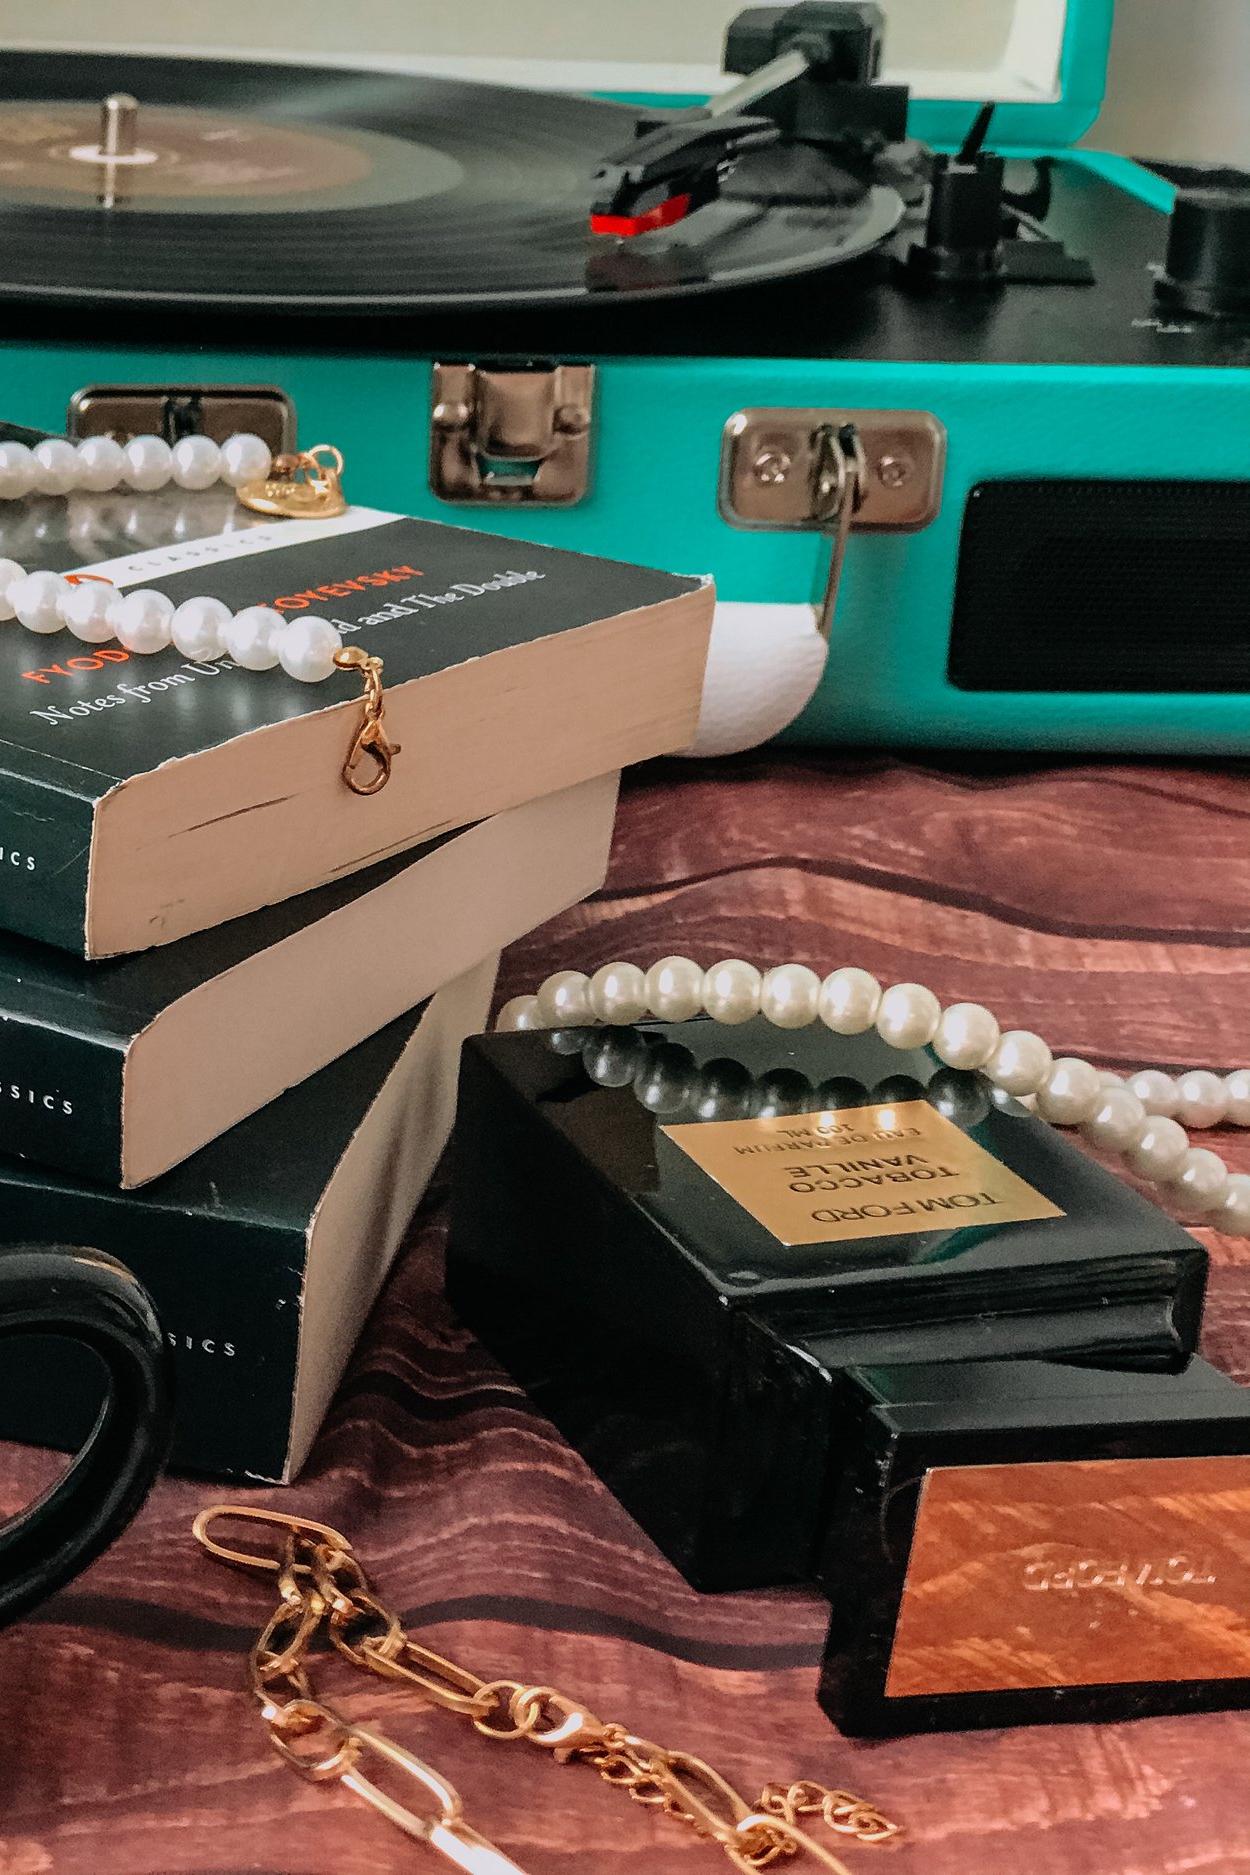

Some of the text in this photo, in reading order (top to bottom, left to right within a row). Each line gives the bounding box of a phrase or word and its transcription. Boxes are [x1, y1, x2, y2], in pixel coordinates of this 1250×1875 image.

[21, 648, 132, 685] FYOD
[257, 565, 425, 614] OYEVSKY
[29, 693, 127, 726] Notes
[116, 672, 196, 704] from
[357, 602, 420, 626] and
[400, 591, 466, 610] The
[448, 569, 547, 597] Double
[776, 1127, 811, 1139] ML
[836, 1133, 868, 1146] DE
[784, 1154, 928, 1178] VANILLE
[788, 1165, 960, 1194] TOBACCO
[810, 1191, 1005, 1224] TOM FORD
[167, 1332, 236, 1357] SICS
